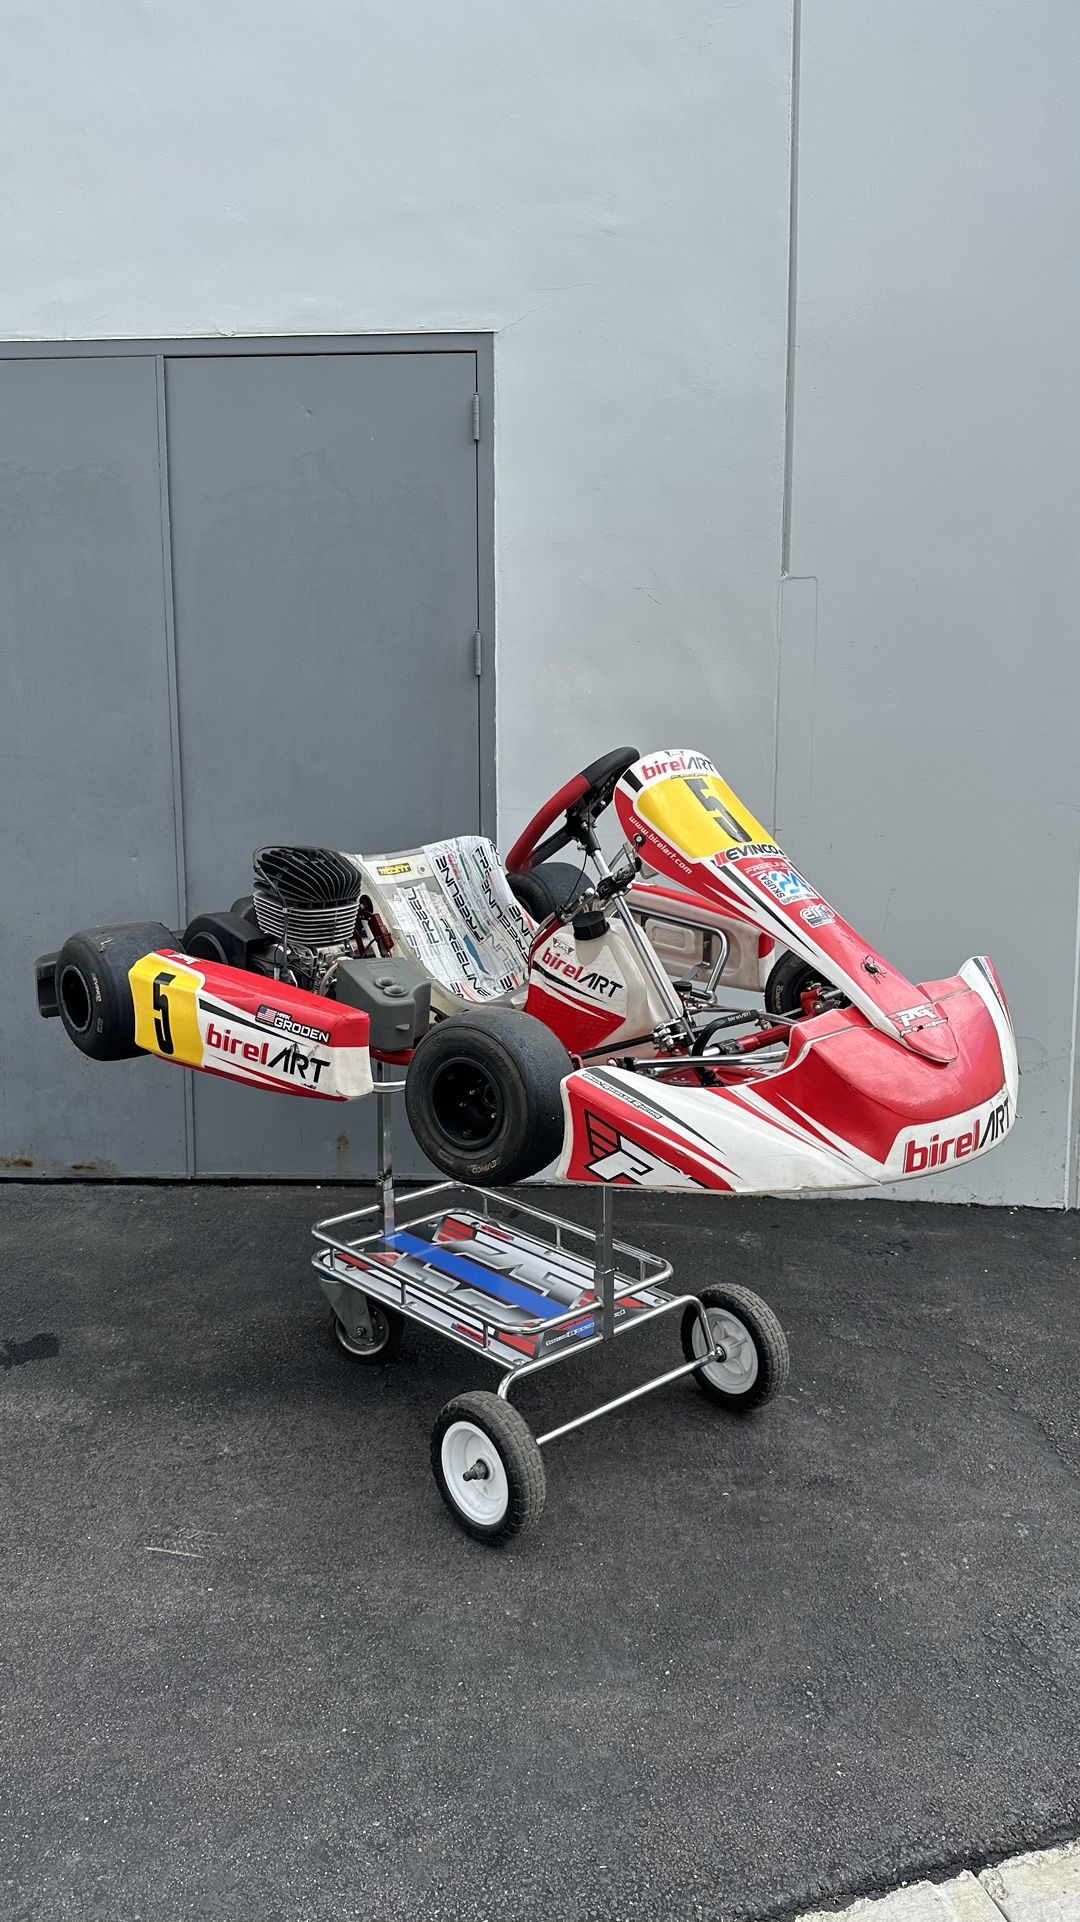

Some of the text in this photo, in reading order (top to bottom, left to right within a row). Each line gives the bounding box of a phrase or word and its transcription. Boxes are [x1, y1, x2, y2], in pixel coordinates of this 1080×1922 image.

[641, 756, 714, 780] birelART
[683, 778, 752, 843] 5
[628, 815, 693, 876] www.birelart.com
[726, 844, 777, 861] EVINCO
[435, 855, 484, 943] FREELINE
[760, 874, 785, 899] SKUSA
[440, 917, 492, 998] FREELINE
[541, 947, 623, 998] birelART
[152, 971, 177, 1056] 5
[274, 1018, 330, 1043] GRODEN
[276, 1011, 291, 1021] MARK
[206, 1023, 331, 1083] birelART
[902, 1097, 1011, 1174] birelART
[471, 1159, 497, 1174] EVINCO
